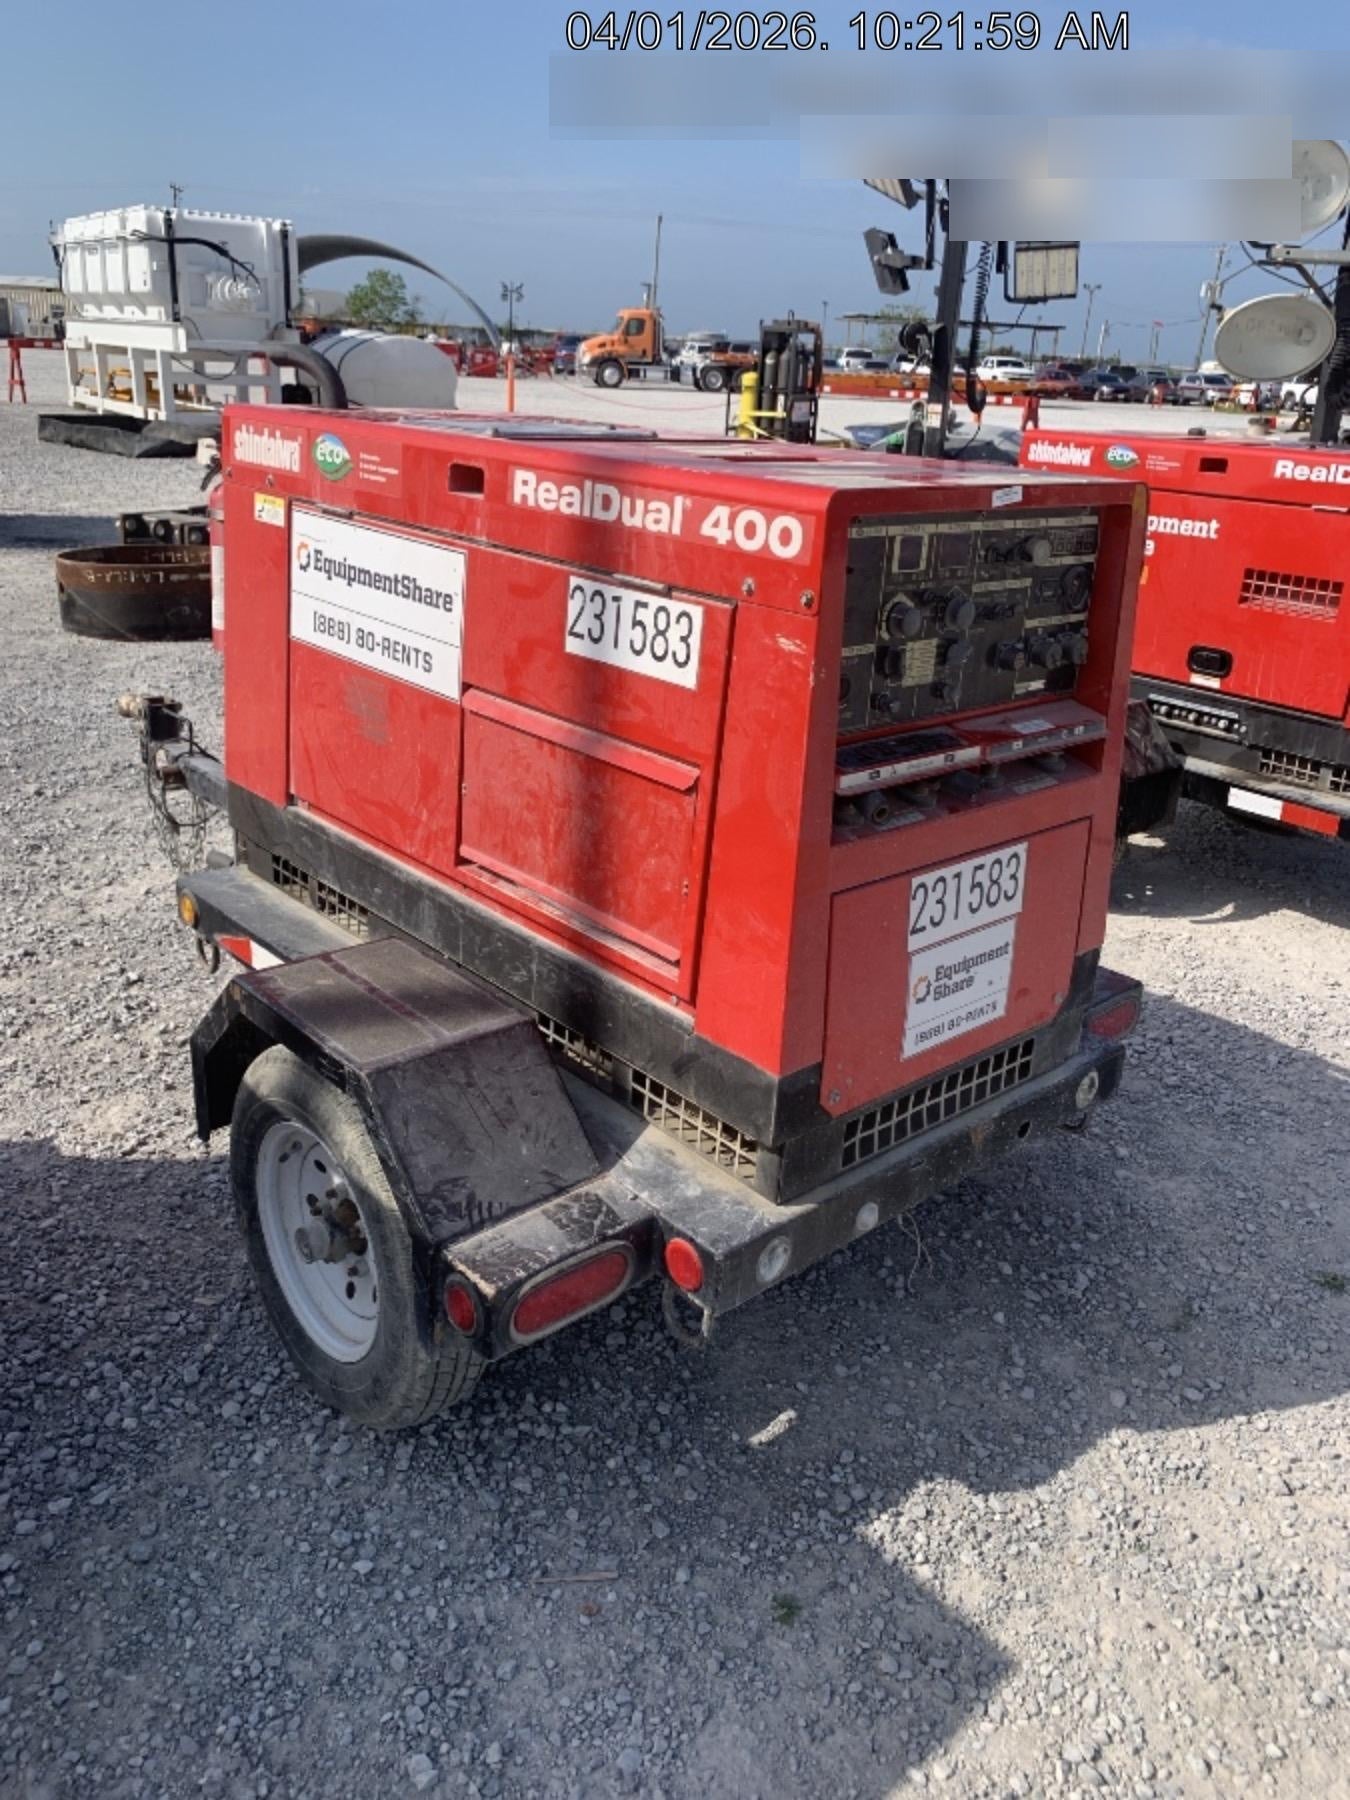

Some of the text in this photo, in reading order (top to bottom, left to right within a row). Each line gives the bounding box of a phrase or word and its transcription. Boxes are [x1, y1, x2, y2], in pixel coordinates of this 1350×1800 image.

[234, 423, 302, 473] shindaiwa
[316, 443, 344, 465] eco
[1274, 459, 1350, 485] RealD
[513, 469, 803, 559] RealDual 400
[1147, 515, 1221, 540] pment
[313, 549, 453, 612] EquipmentShare
[568, 584, 694, 669] 231583
[355, 627, 433, 674] 80-RENTS
[910, 851, 1021, 936] 231583
[933, 941, 1011, 982] Equipment
[933, 974, 976, 1002] Share
